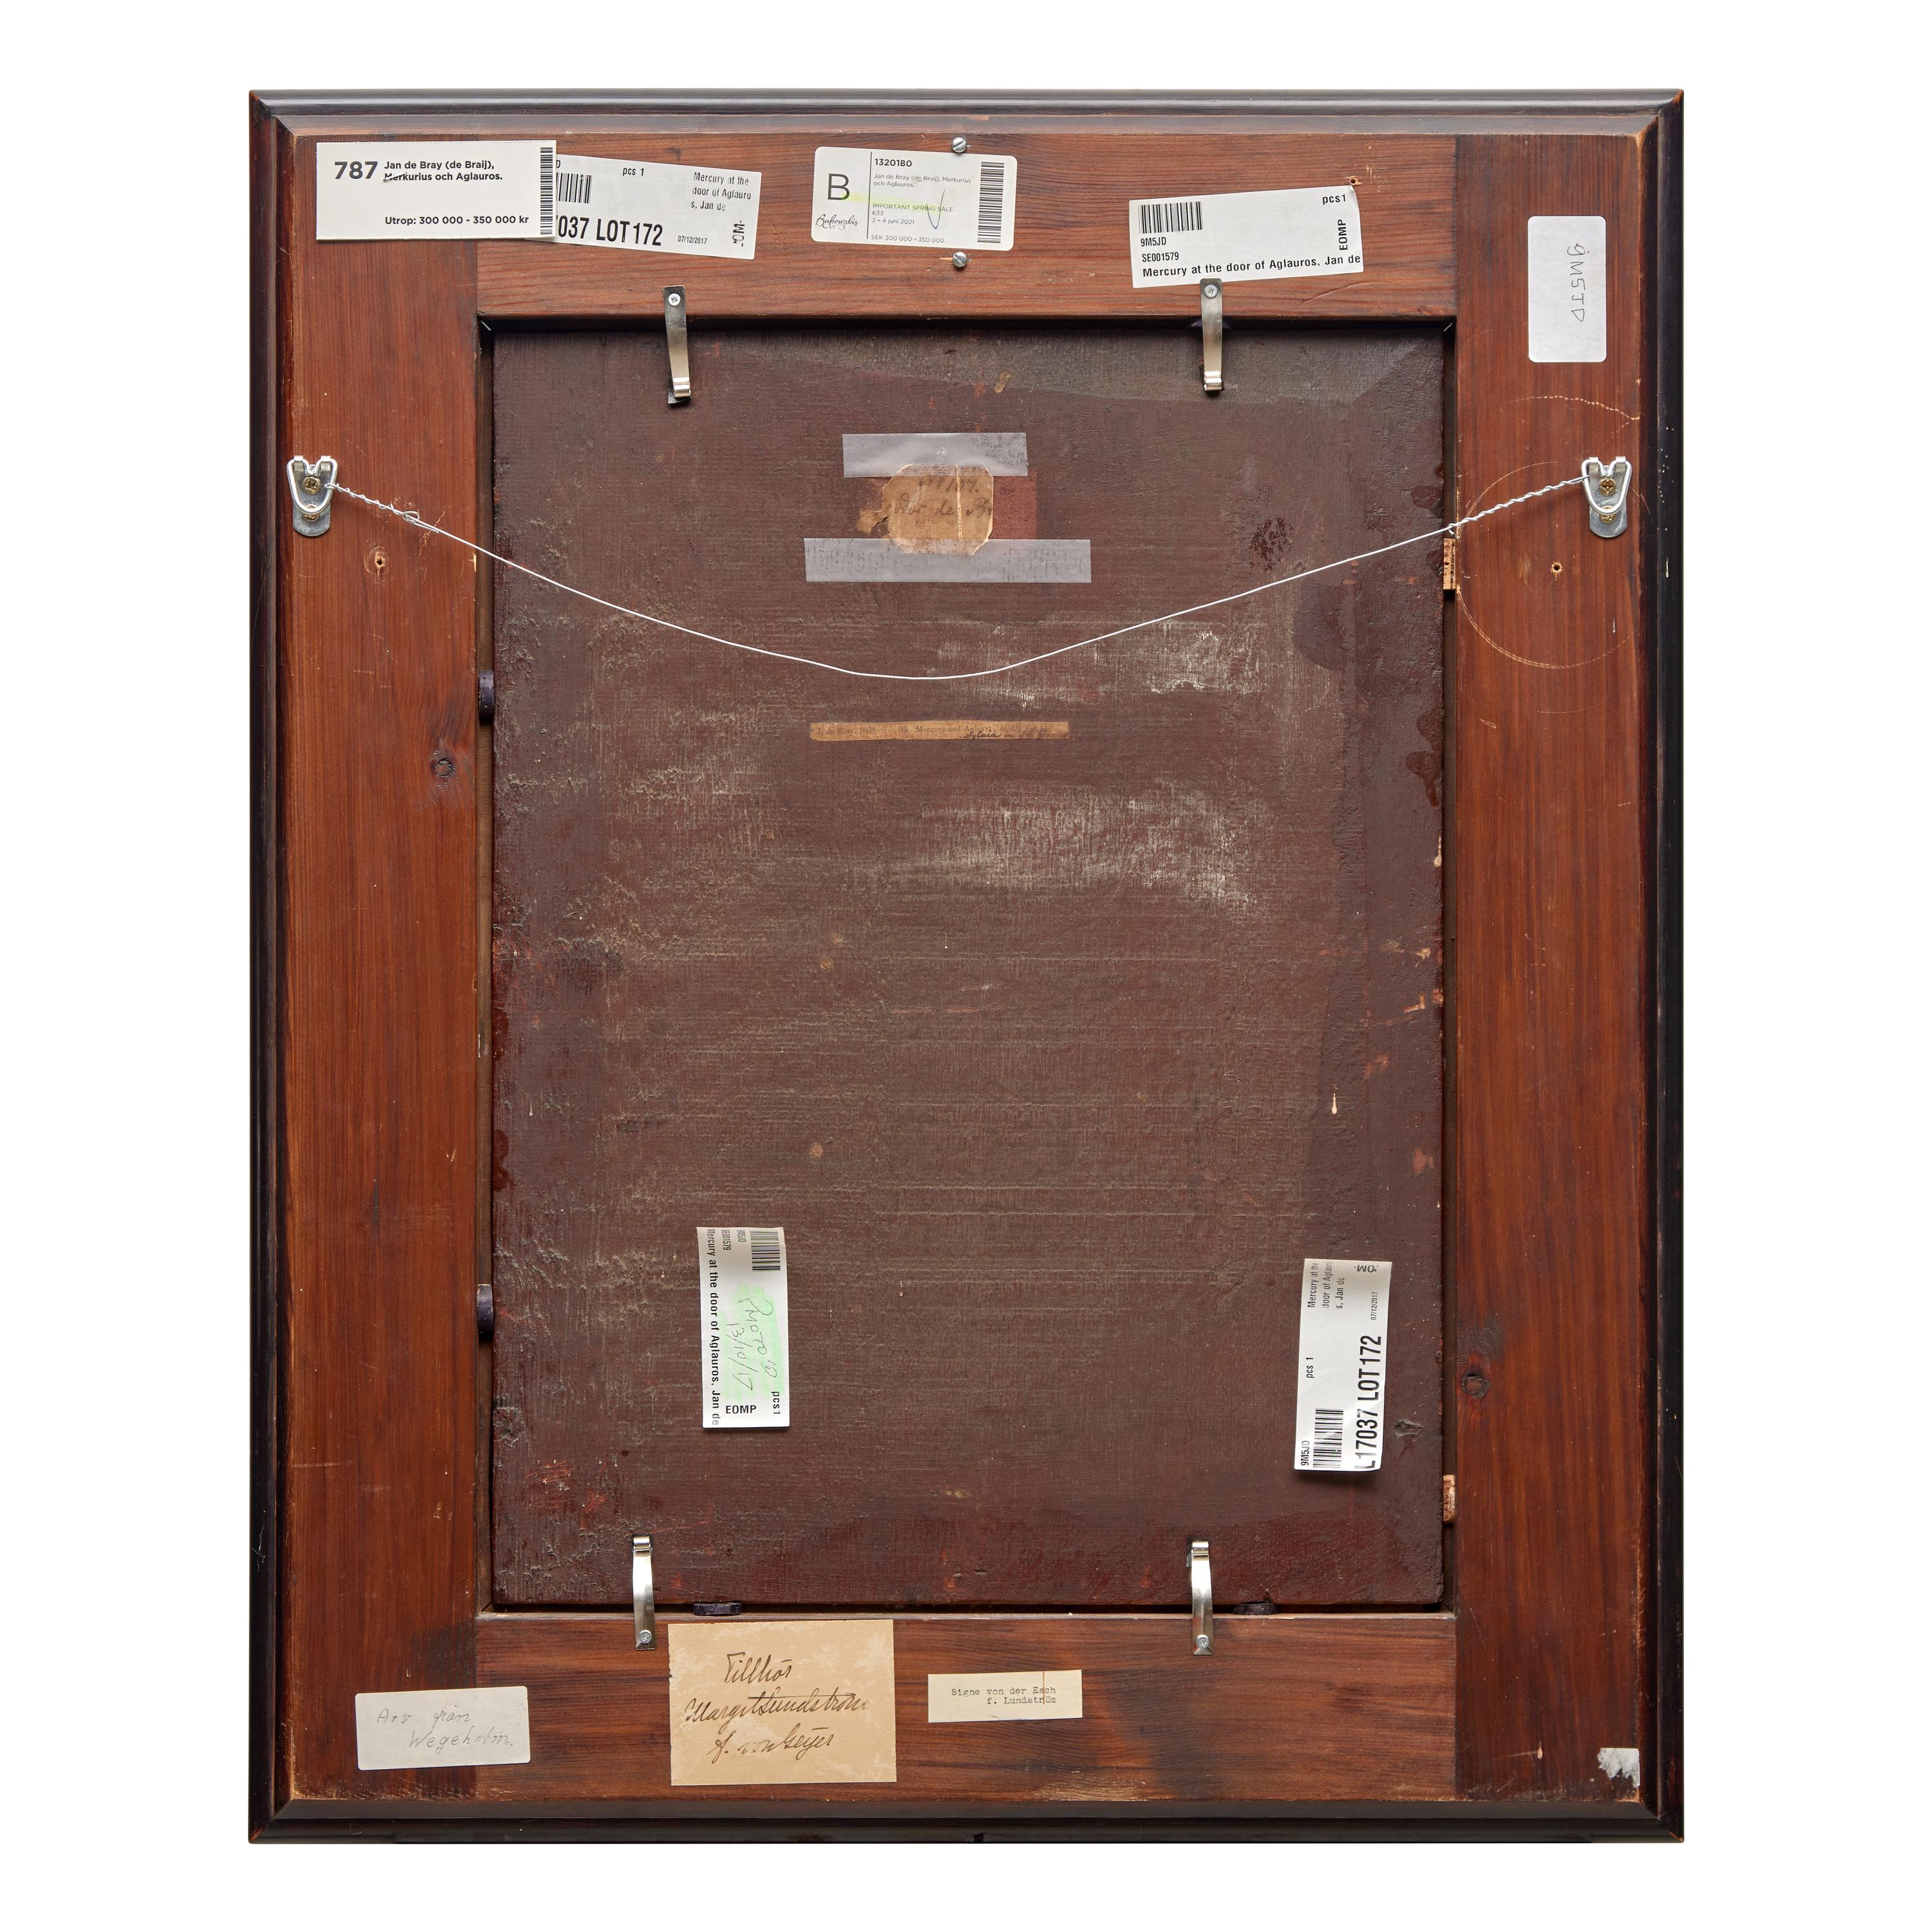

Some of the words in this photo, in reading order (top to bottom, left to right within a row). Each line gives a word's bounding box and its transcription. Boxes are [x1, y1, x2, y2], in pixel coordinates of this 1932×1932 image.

[420, 161, 442, 170] Bray
[446, 160, 462, 169] (de
[465, 160, 495, 170] Braij),
[875, 158, 912, 167] 1320180
[334, 161, 378, 179] 787
[623, 167, 636, 176] pcs
[641, 167, 644, 176] 1
[435, 172, 453, 180] och
[456, 173, 503, 182] Aglauros.
[694, 172, 724, 185] Mercury
[728, 176, 735, 184] at
[738, 176, 749, 185] the
[828, 173, 849, 200] B
[692, 187, 709, 196] door
[712, 188, 719, 196] of
[722, 189, 752, 200] Aglauro
[700, 200, 713, 210] Jan
[385, 216, 416, 225] Utrop:
[519, 215, 529, 223] kr
[556, 214, 589, 239] 037
[815, 214, 860, 230] Bukowskis
[677, 236, 707, 244] 07/12/2017
[1141, 236, 1167, 247] 9M5JD
[1338, 219, 1348, 251] EOMP
[1142, 252, 1179, 262] SE001579
[1143, 267, 1187, 278] Mercury
[1191, 265, 1201, 274] at
[1205, 264, 1222, 273] the
[1227, 262, 1251, 272] door
[1255, 261, 1265, 270] of
[1325, 256, 1343, 265] Jan
[1349, 254, 1361, 263] de
[1567, 243, 1586, 322] 9M5JD
[934, 500, 954, 515] de
[916, 726, 945, 734] Mercury
[707, 1229, 715, 1256] Mercury
[721, 1229, 732, 1251] SE001579
[709, 1260, 717, 1269] at
[1307, 1279, 1319, 1307] Mercury
[1335, 1288, 1344, 1300] Jan
[1321, 1293, 1330, 1308] door
[711, 1321, 719, 1331] of
[709, 1335, 720, 1385] Aglauros,
[725, 1323, 759, 1390] 13/10/17
[1306, 1365, 1314, 1378] pcs
[712, 1390, 721, 1409] Jan
[726, 1405, 757, 1414] EOMP
[712, 1412, 720, 1425] de
[1355, 1408, 1378, 1469] L17037
[1301, 1441, 1309, 1466] 9M5JD
[951, 1689, 980, 1697] Signe
[1004, 1696, 1056, 1704] Lundström
[377, 1709, 412, 1724] Arv
